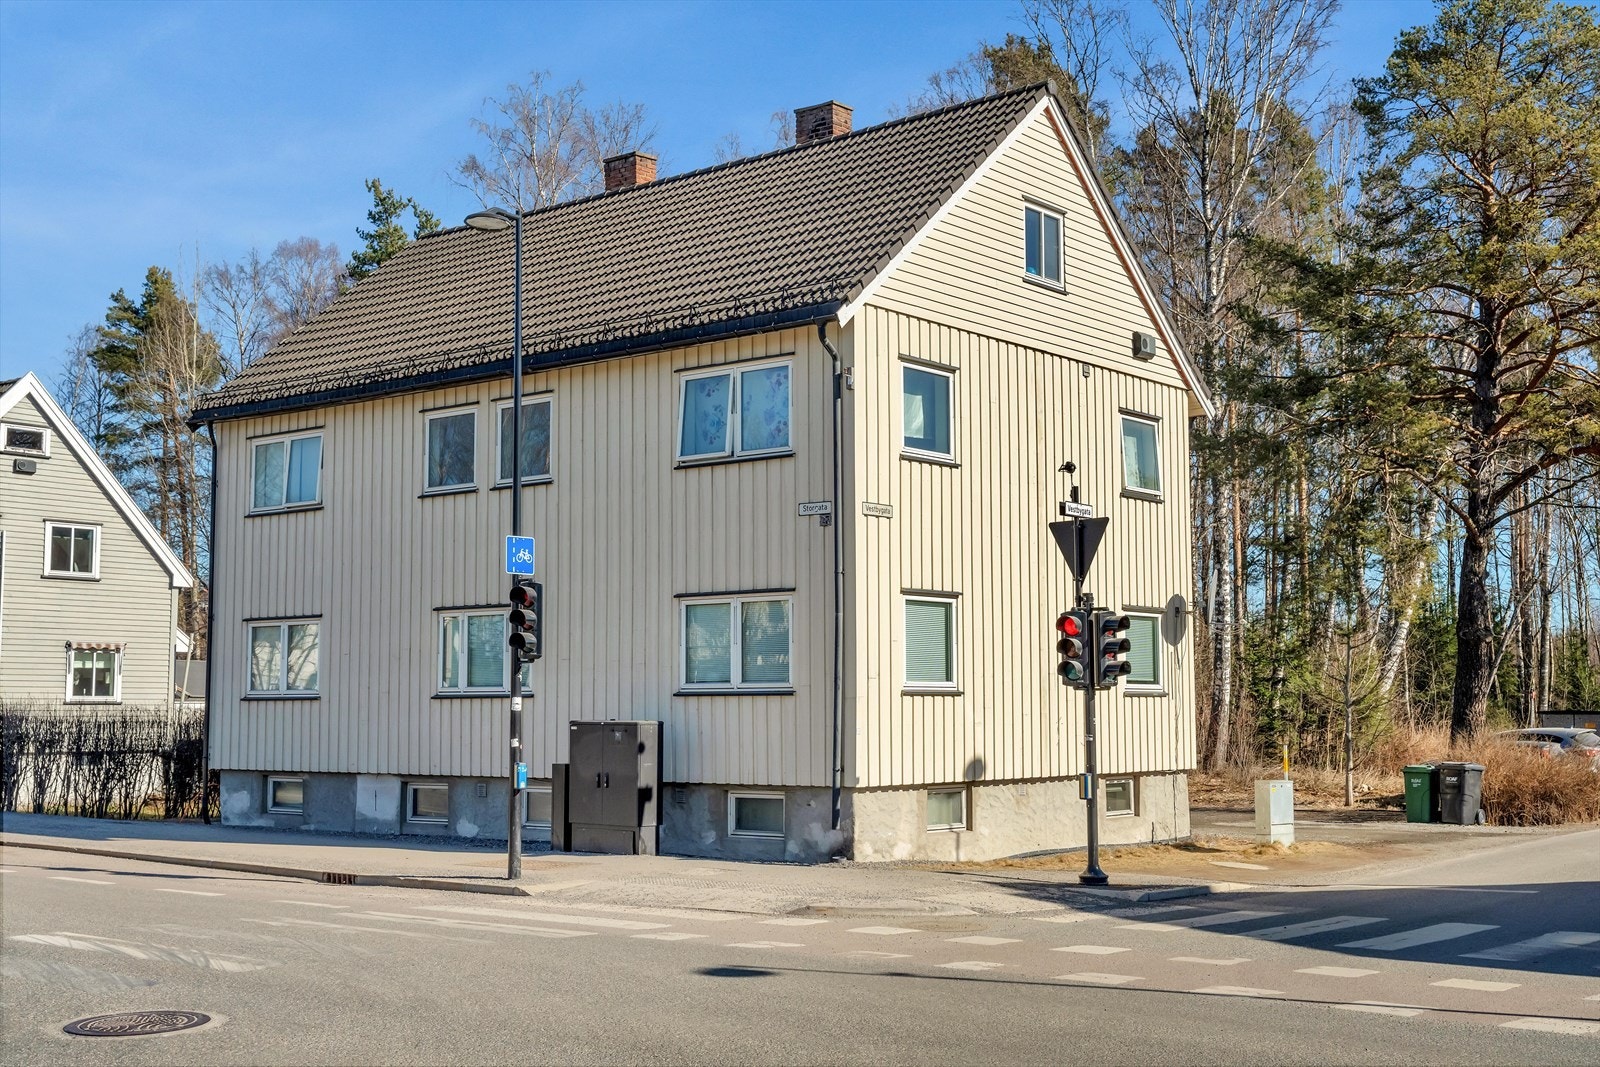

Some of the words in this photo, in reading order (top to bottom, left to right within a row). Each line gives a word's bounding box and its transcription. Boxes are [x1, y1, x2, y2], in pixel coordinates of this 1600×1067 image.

[803, 504, 828, 512] Storgata
[865, 505, 890, 515] Vestbygata
[1067, 504, 1091, 516] Vestbygata
